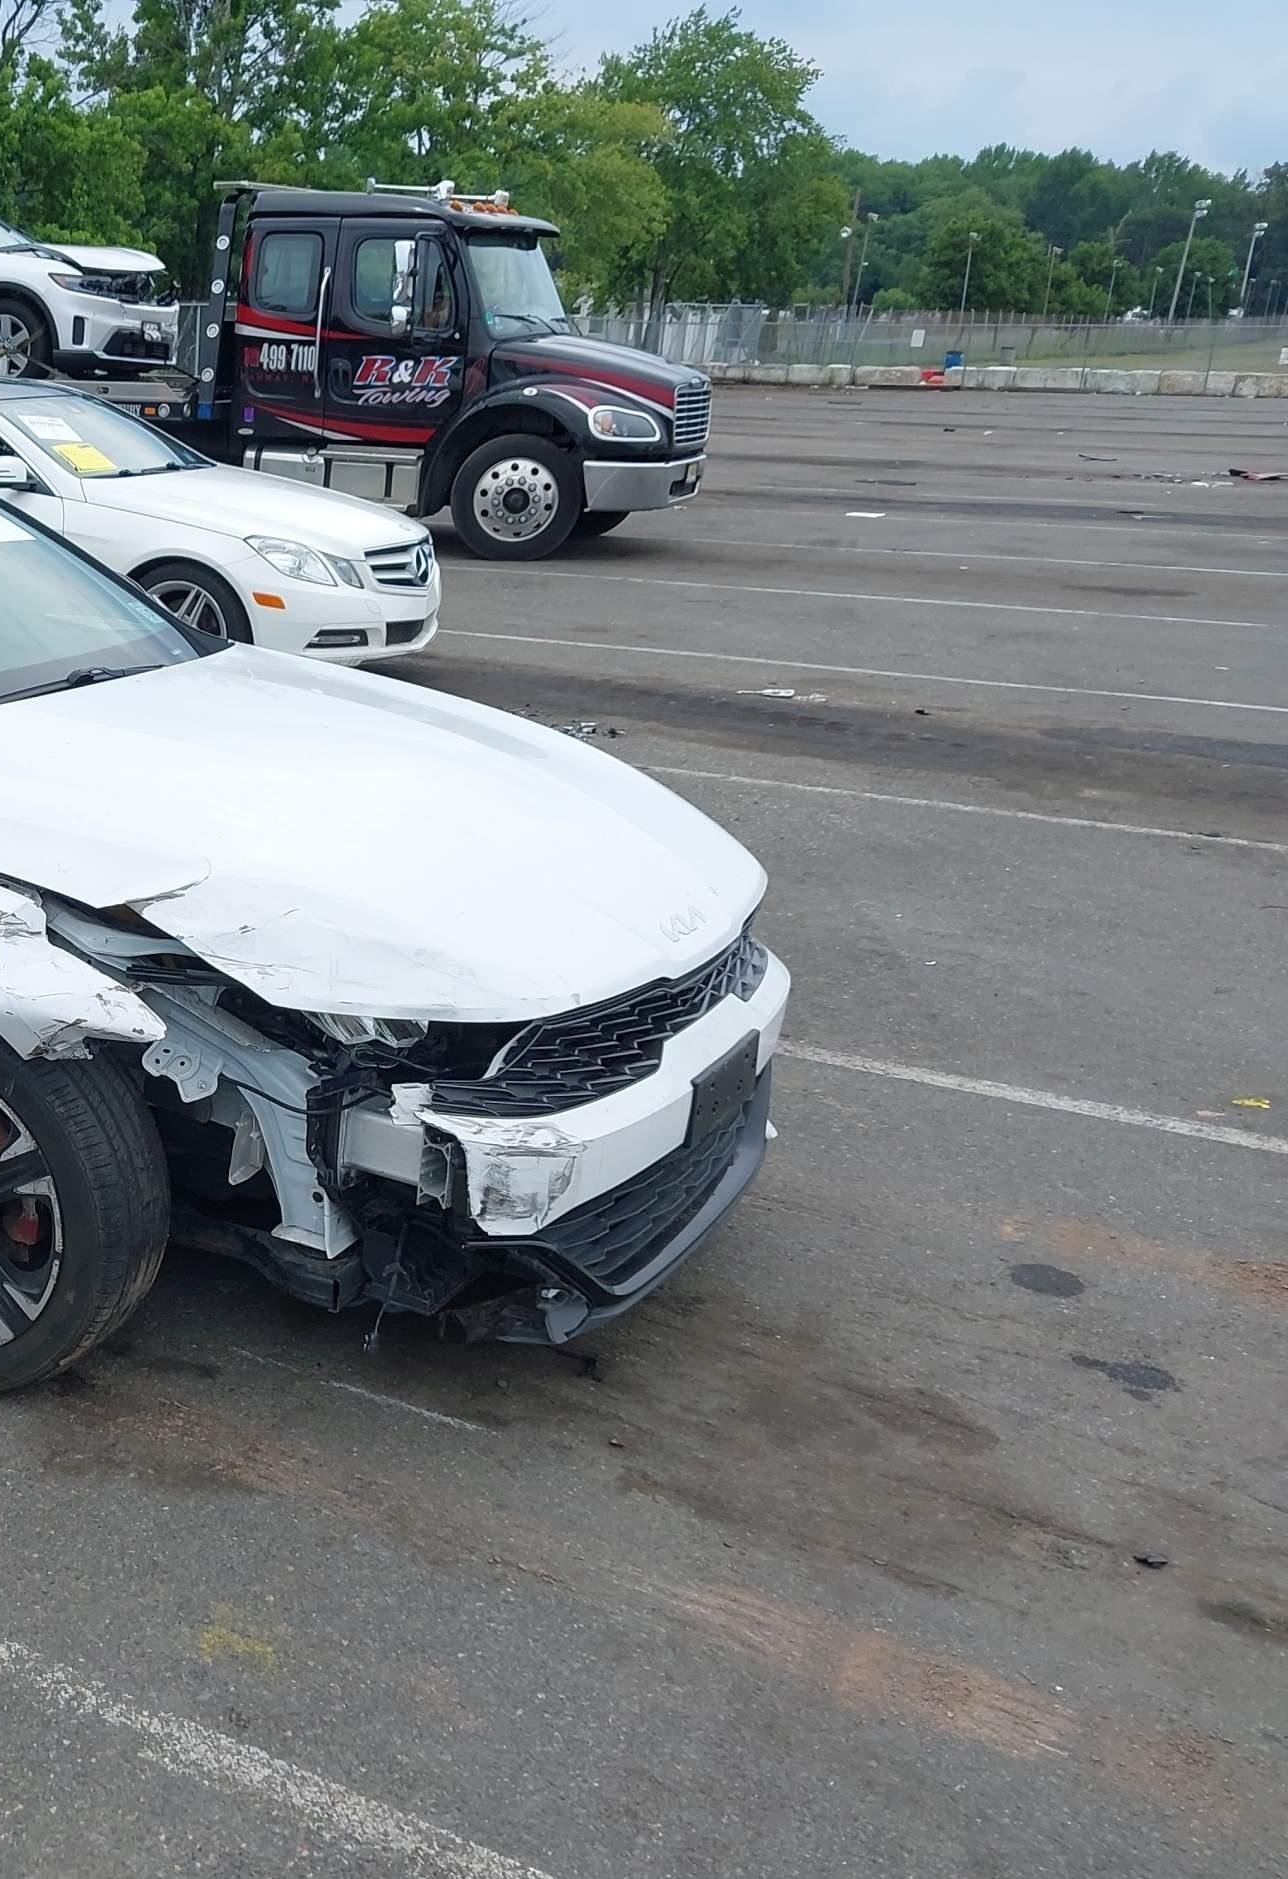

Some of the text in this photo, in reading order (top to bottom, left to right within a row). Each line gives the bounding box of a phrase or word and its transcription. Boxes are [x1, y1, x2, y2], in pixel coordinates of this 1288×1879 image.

[290, 343, 316, 372] 7110
[352, 355, 459, 386] R&K
[352, 387, 452, 408] Towing
